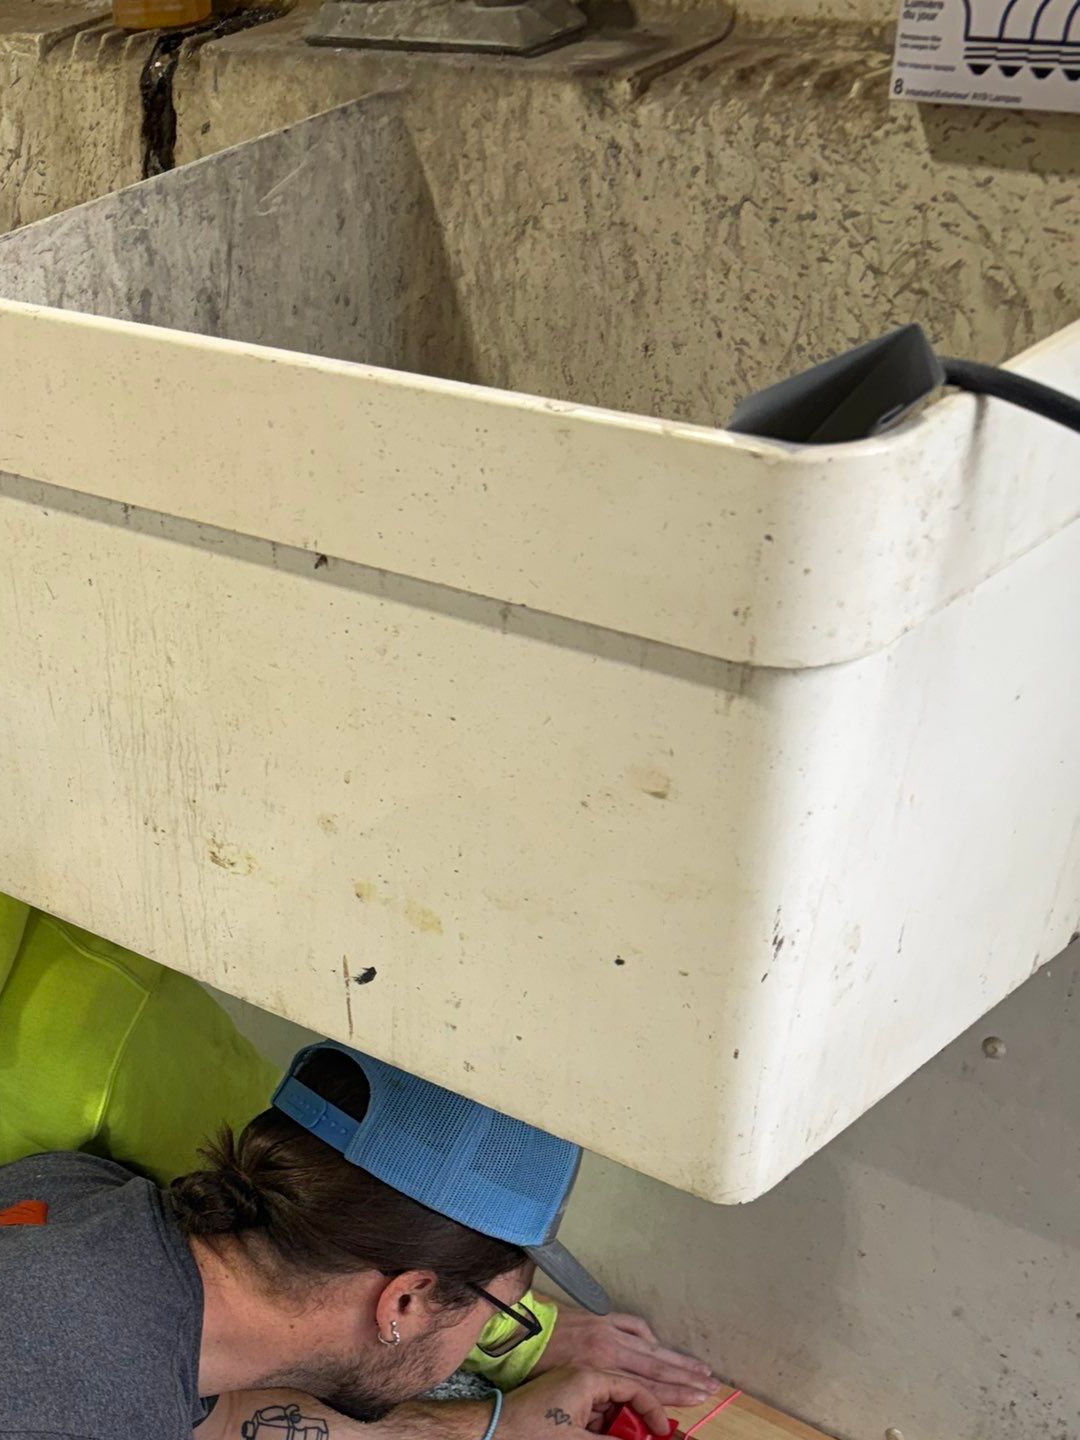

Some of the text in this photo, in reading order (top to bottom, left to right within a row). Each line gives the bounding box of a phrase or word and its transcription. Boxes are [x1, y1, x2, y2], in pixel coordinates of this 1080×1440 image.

[903, 10, 938, 22] du jour
[894, 78, 904, 95] 8
